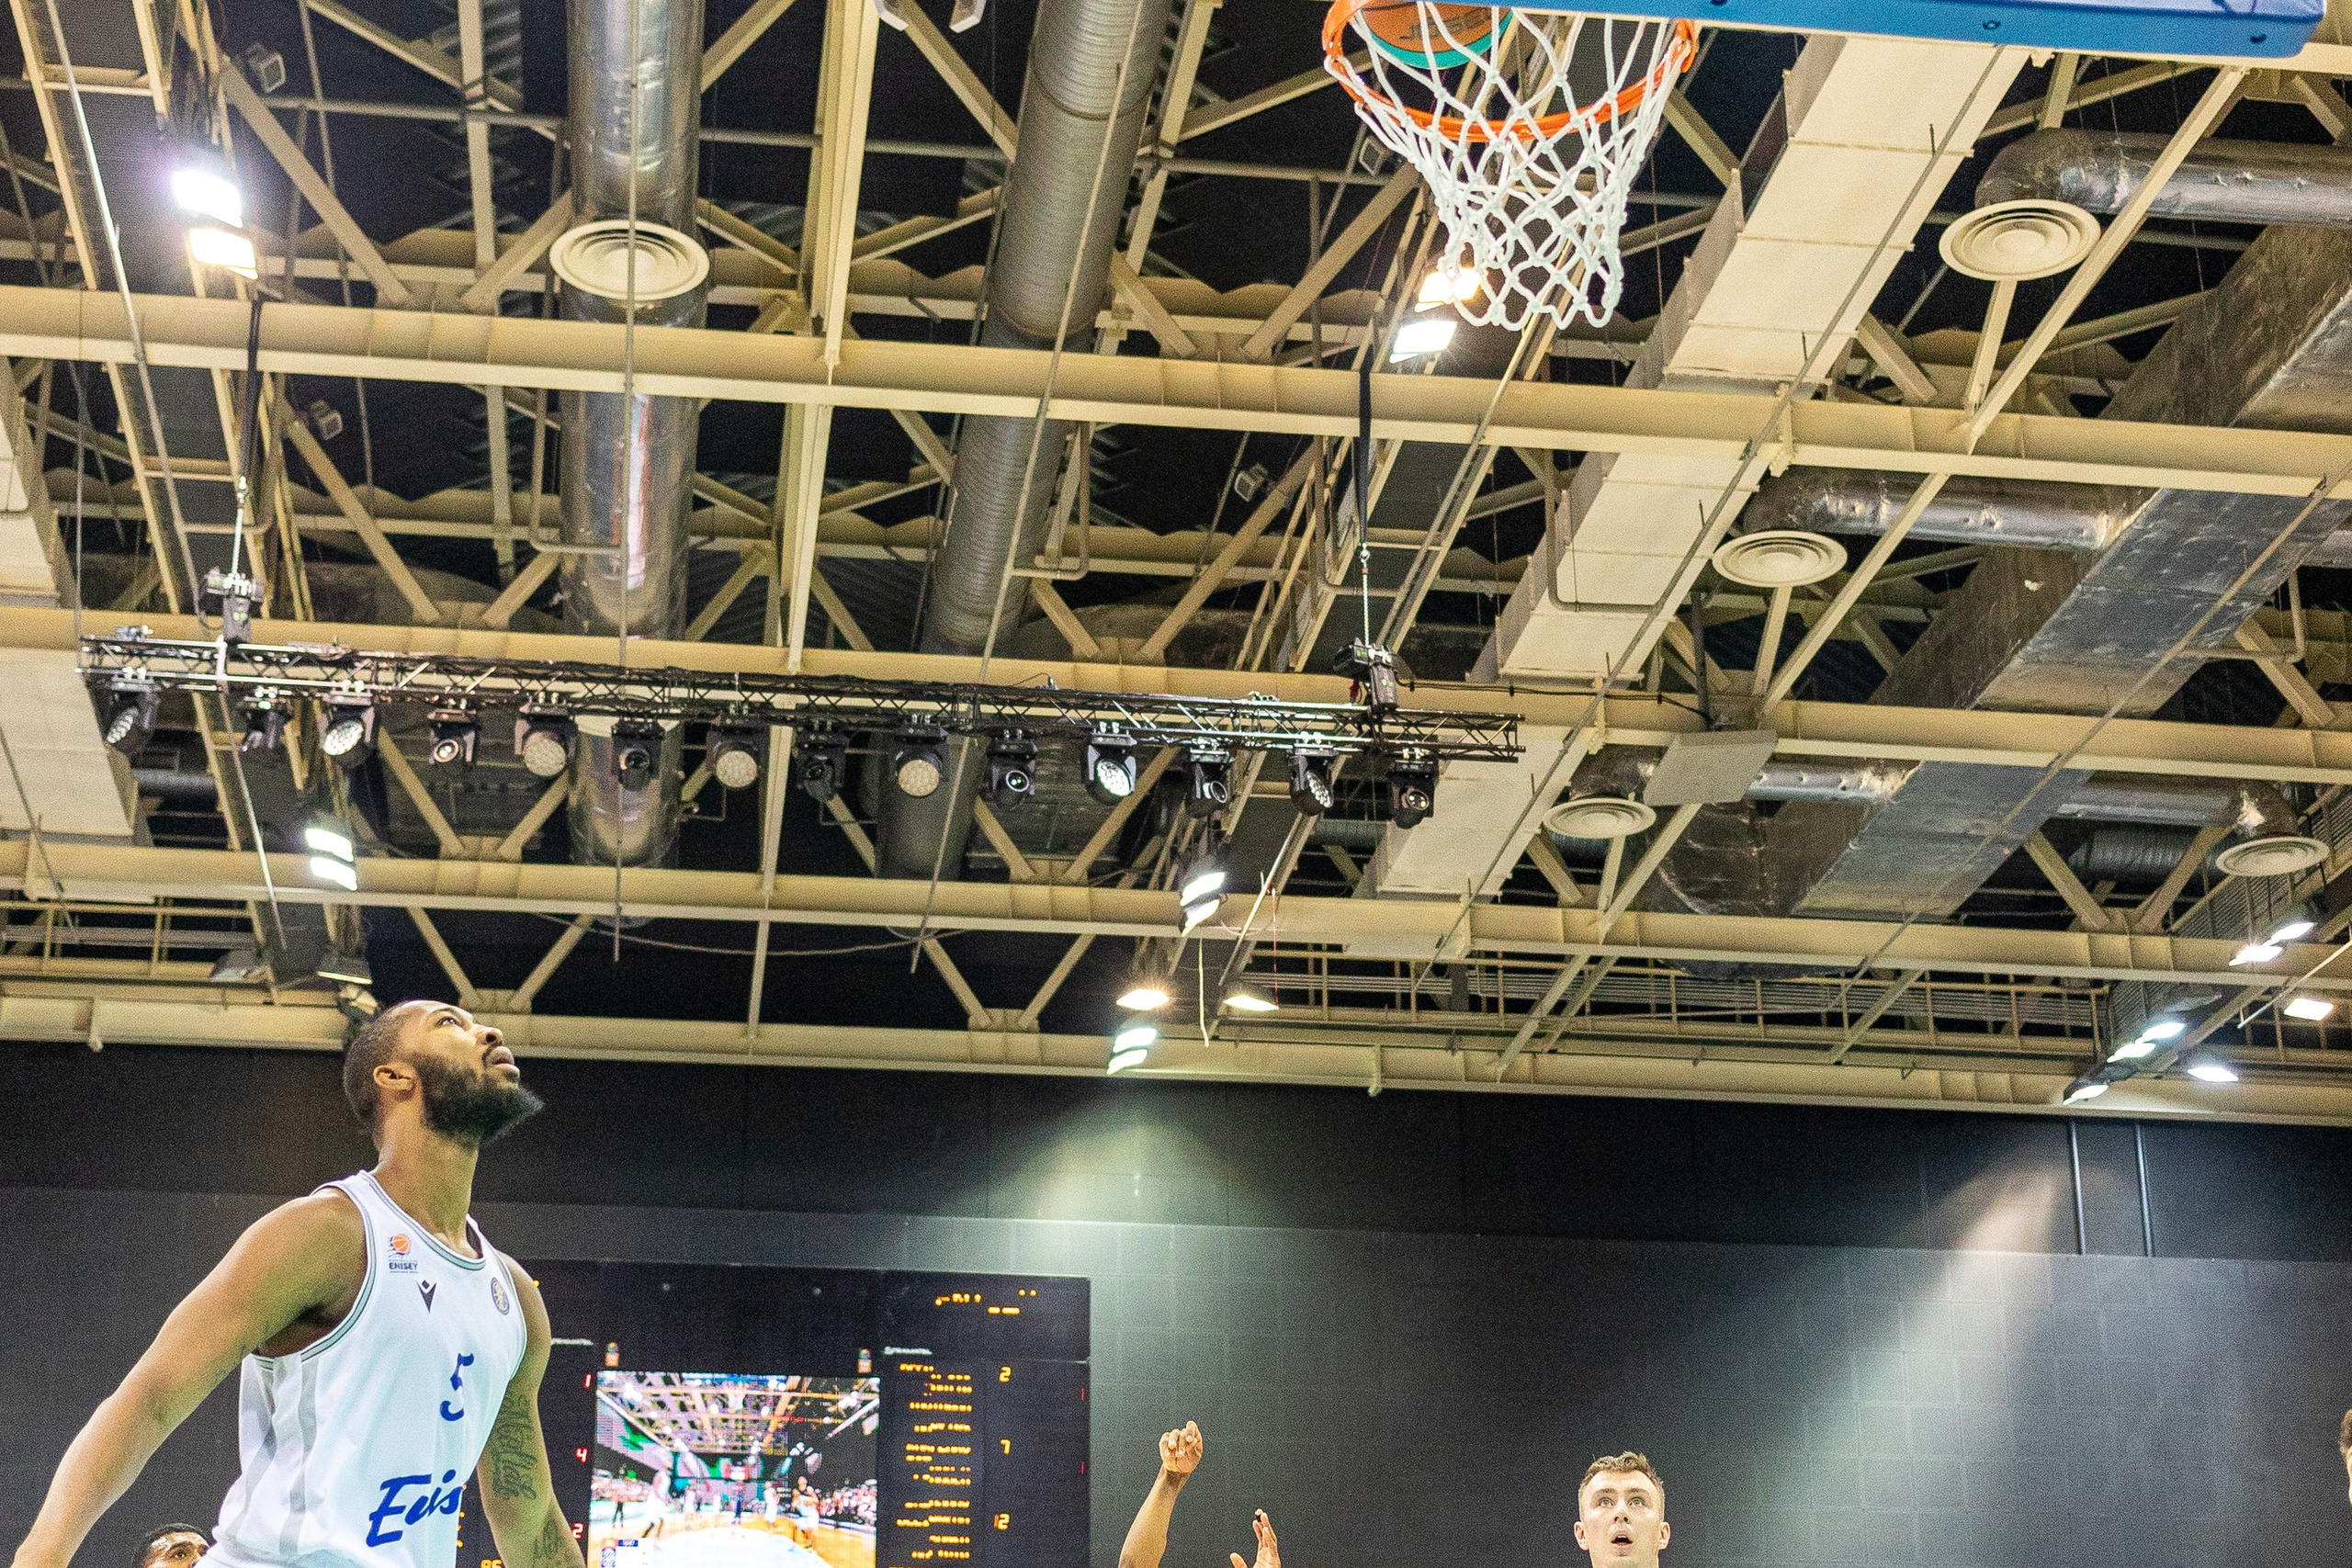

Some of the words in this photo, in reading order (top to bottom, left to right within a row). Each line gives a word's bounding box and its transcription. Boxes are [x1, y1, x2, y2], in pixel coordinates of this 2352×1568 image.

[389, 1262, 418, 1270] ENISEY
[999, 1366, 1012, 1382] 2
[1000, 1438, 1011, 1454] 7
[575, 1448, 588, 1462] 4
[993, 1513, 1010, 1529] 12
[572, 1522, 583, 1539] 2
